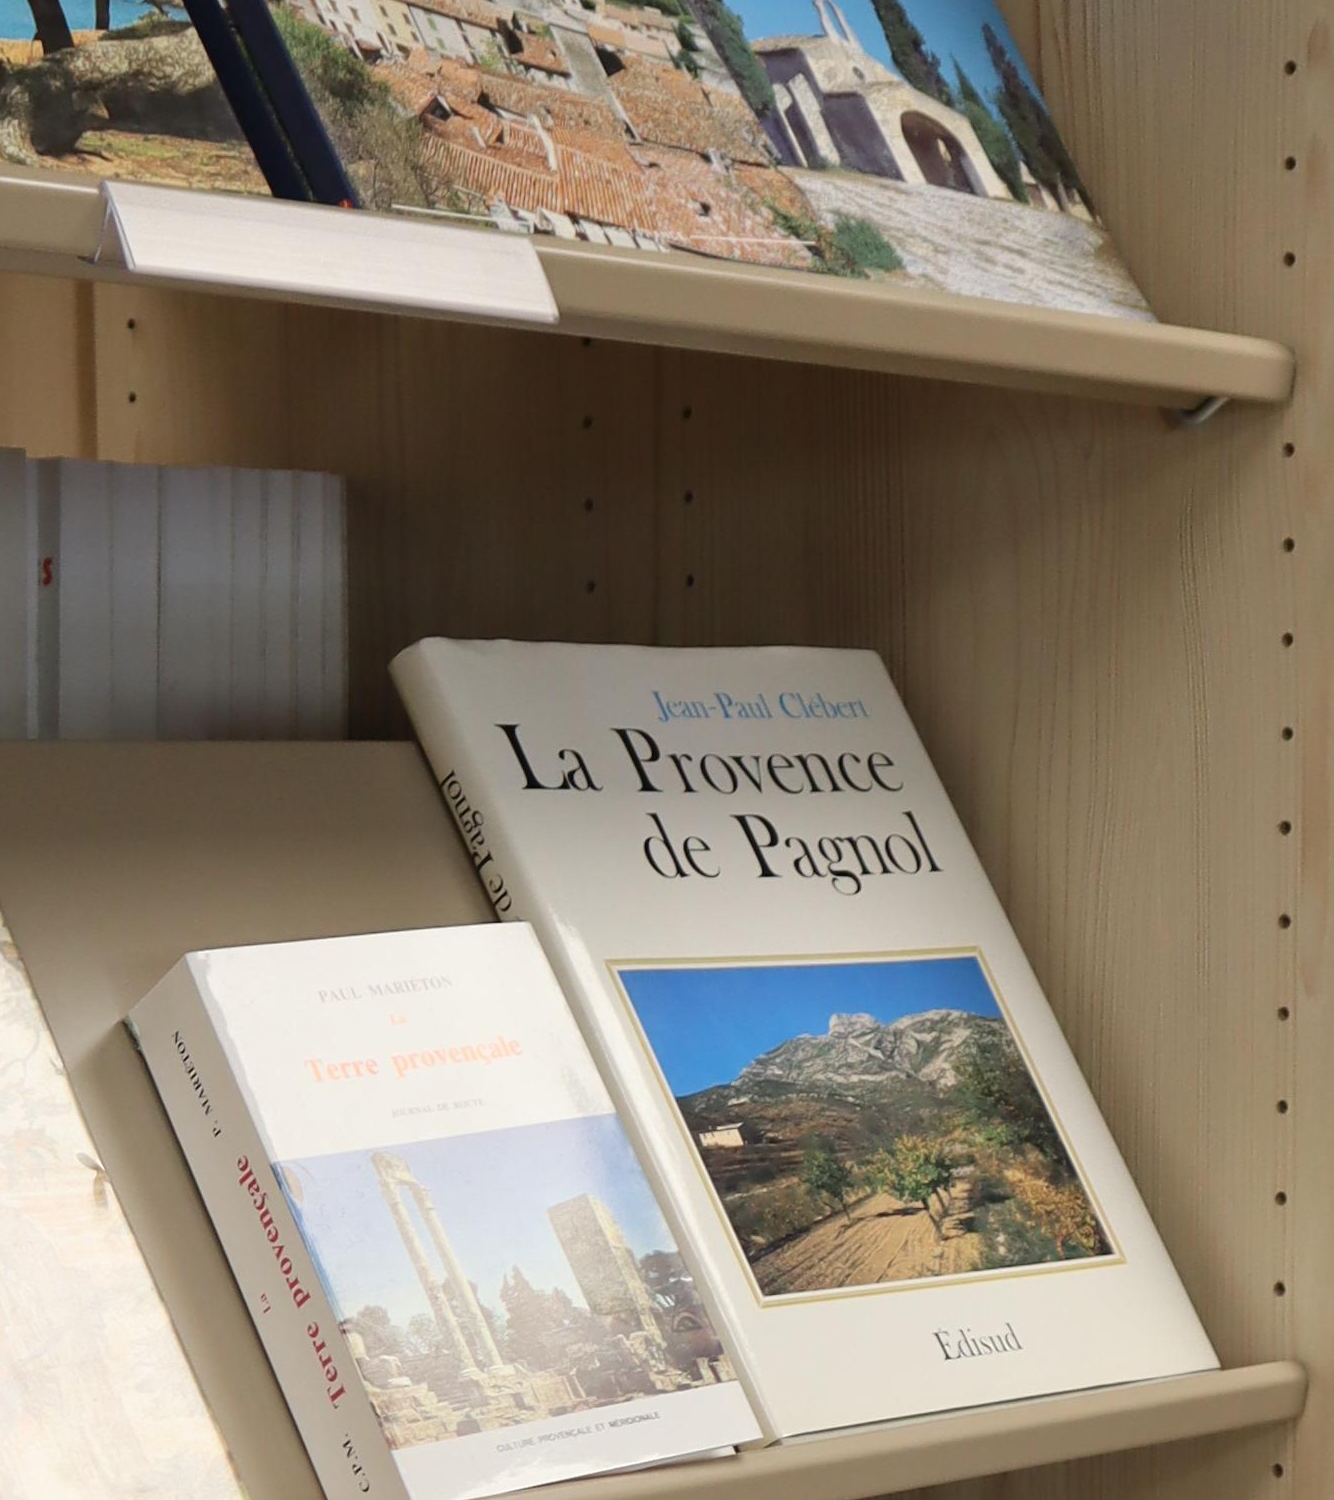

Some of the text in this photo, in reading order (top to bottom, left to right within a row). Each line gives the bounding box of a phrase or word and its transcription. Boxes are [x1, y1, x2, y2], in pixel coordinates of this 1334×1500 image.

[652, 691, 869, 723] Jean-Paul Clébert
[494, 724, 904, 795] La Provence
[642, 810, 944, 895] de Pagnol
[304, 1034, 523, 1085] Terre provençale
[236, 1154, 347, 1409] Terre provençale
[932, 1322, 1023, 1362] Édisud
